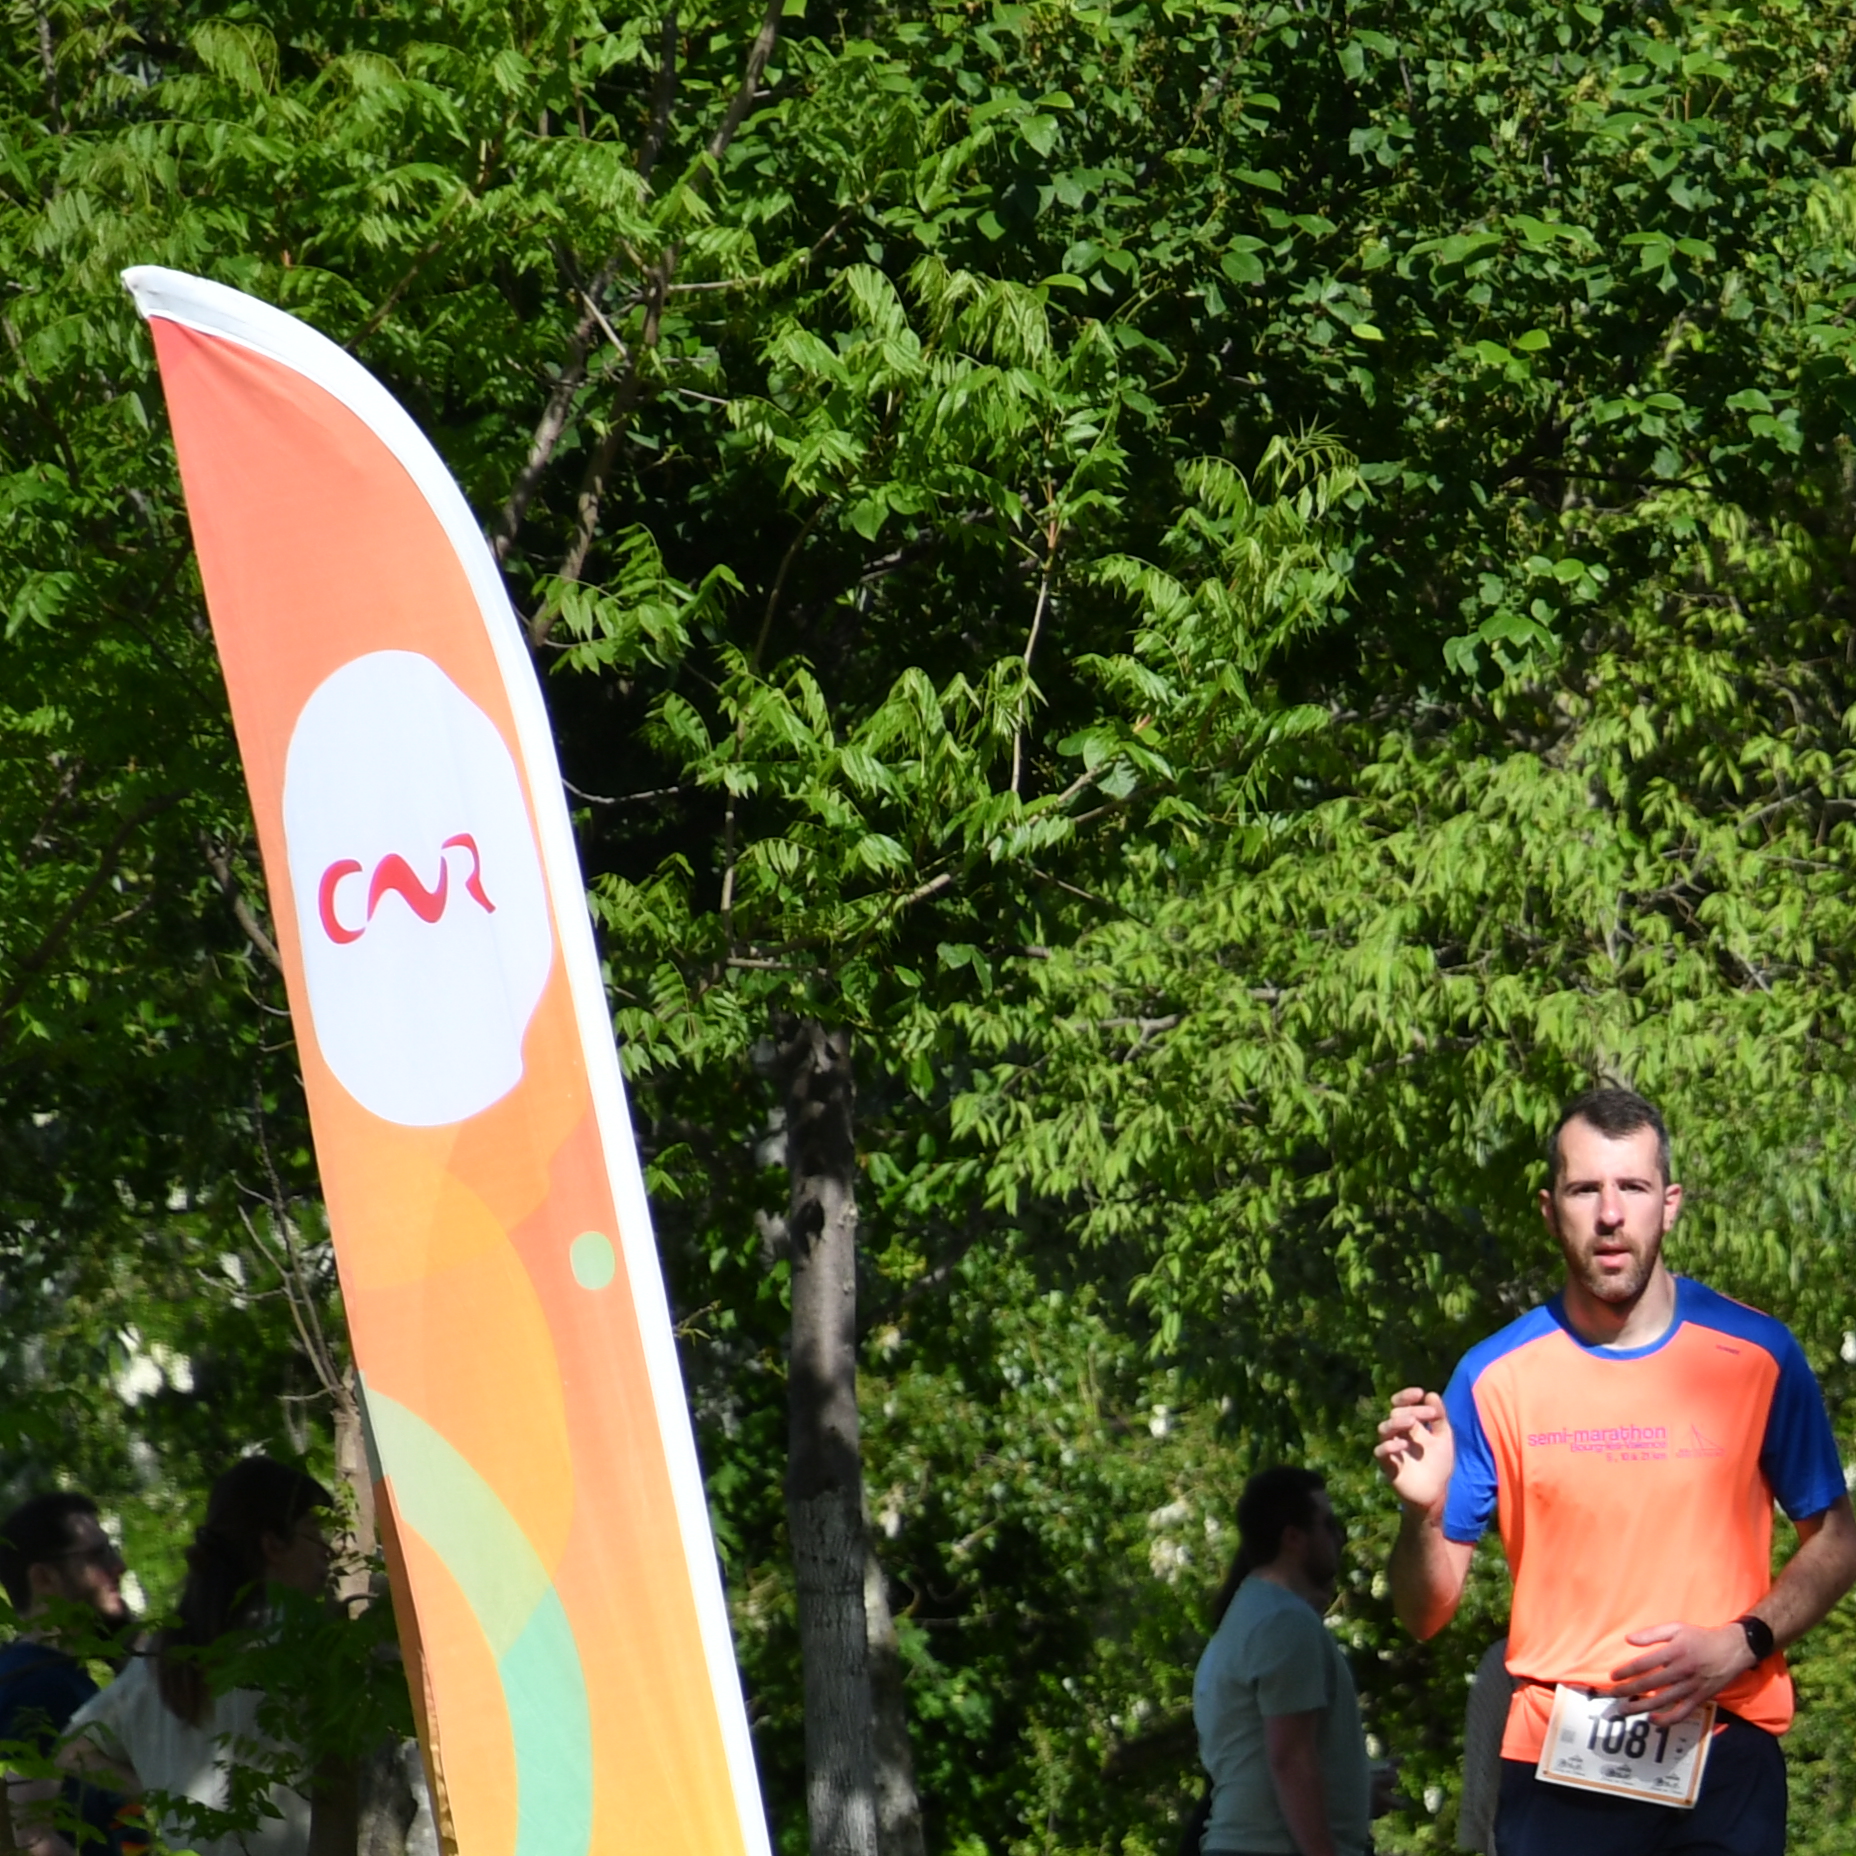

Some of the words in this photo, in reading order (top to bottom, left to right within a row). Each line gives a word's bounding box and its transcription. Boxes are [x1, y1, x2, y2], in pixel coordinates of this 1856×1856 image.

[318, 833, 496, 945] CNR
[1528, 1425, 1666, 1447] semi-marathon
[1587, 1715, 1670, 1763] 1081
